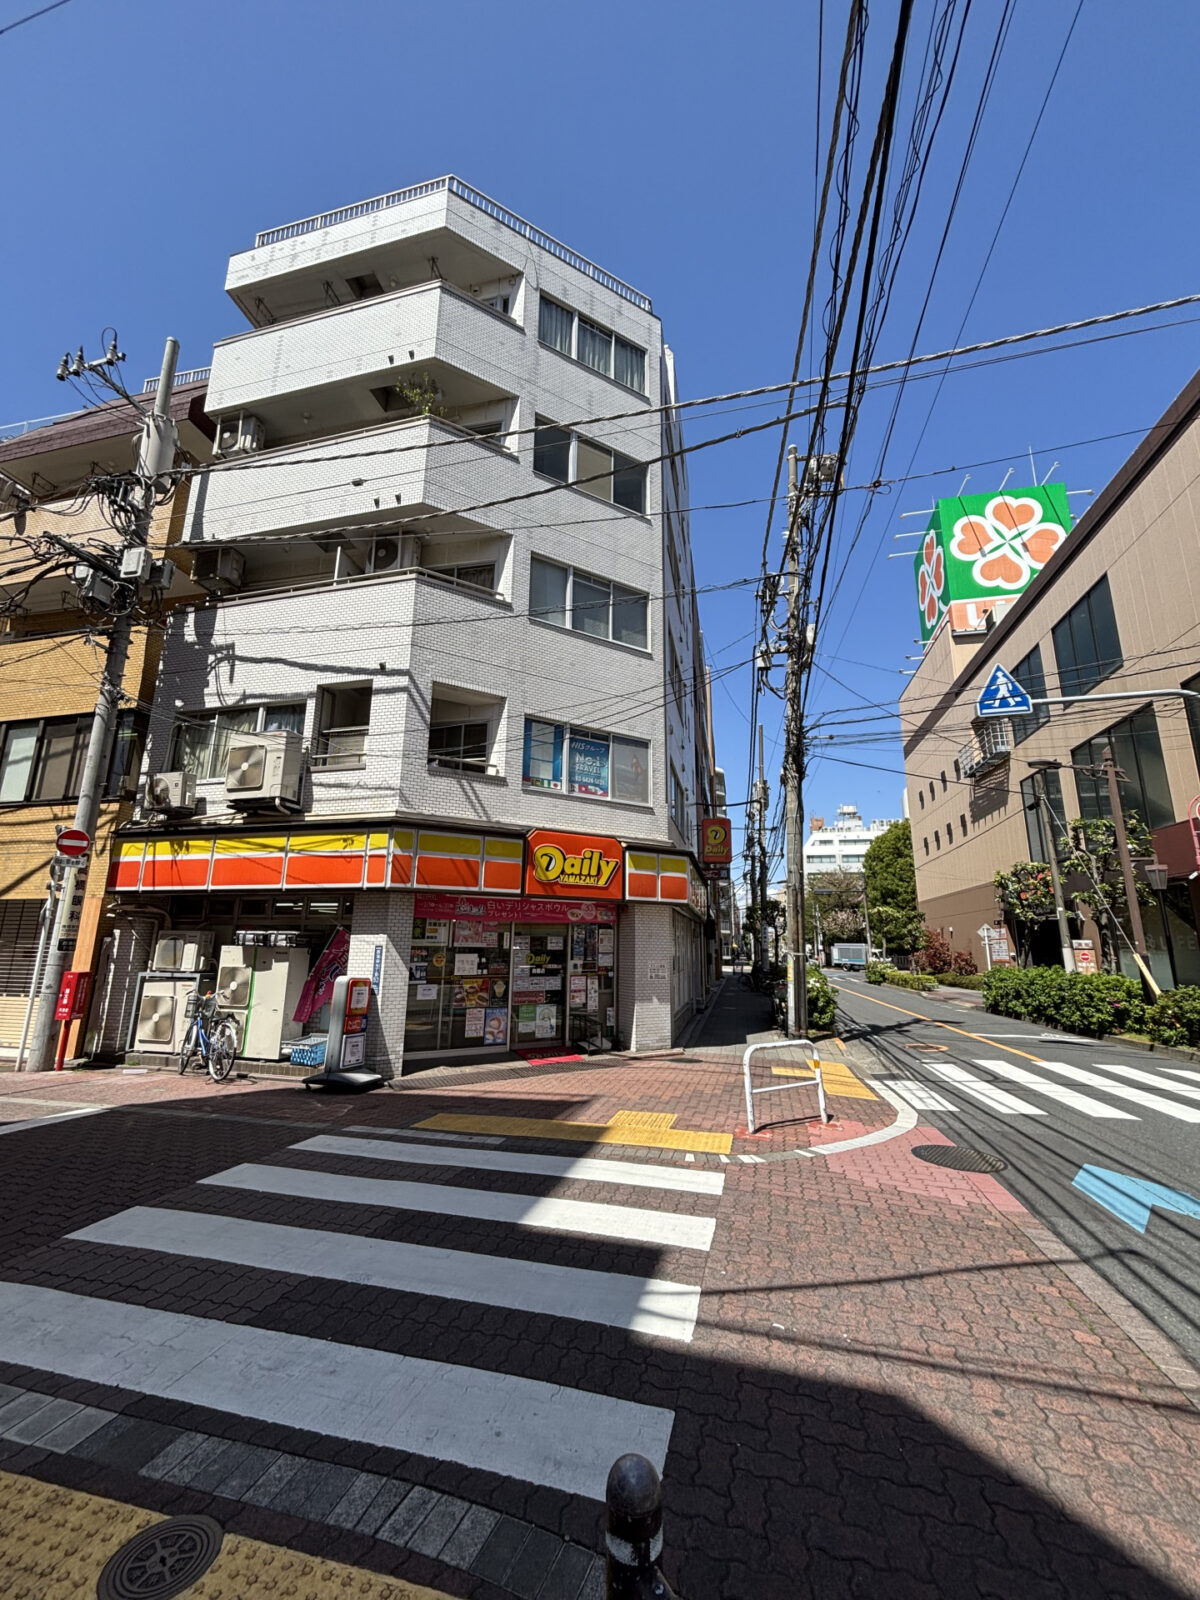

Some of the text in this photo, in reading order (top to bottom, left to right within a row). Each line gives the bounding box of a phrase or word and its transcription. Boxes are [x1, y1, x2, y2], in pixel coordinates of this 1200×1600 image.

[534, 845, 618, 886] Daily
[560, 874, 597, 885] YAMAZAKI
[487, 900, 569, 912] 白いデリシャスボウル
